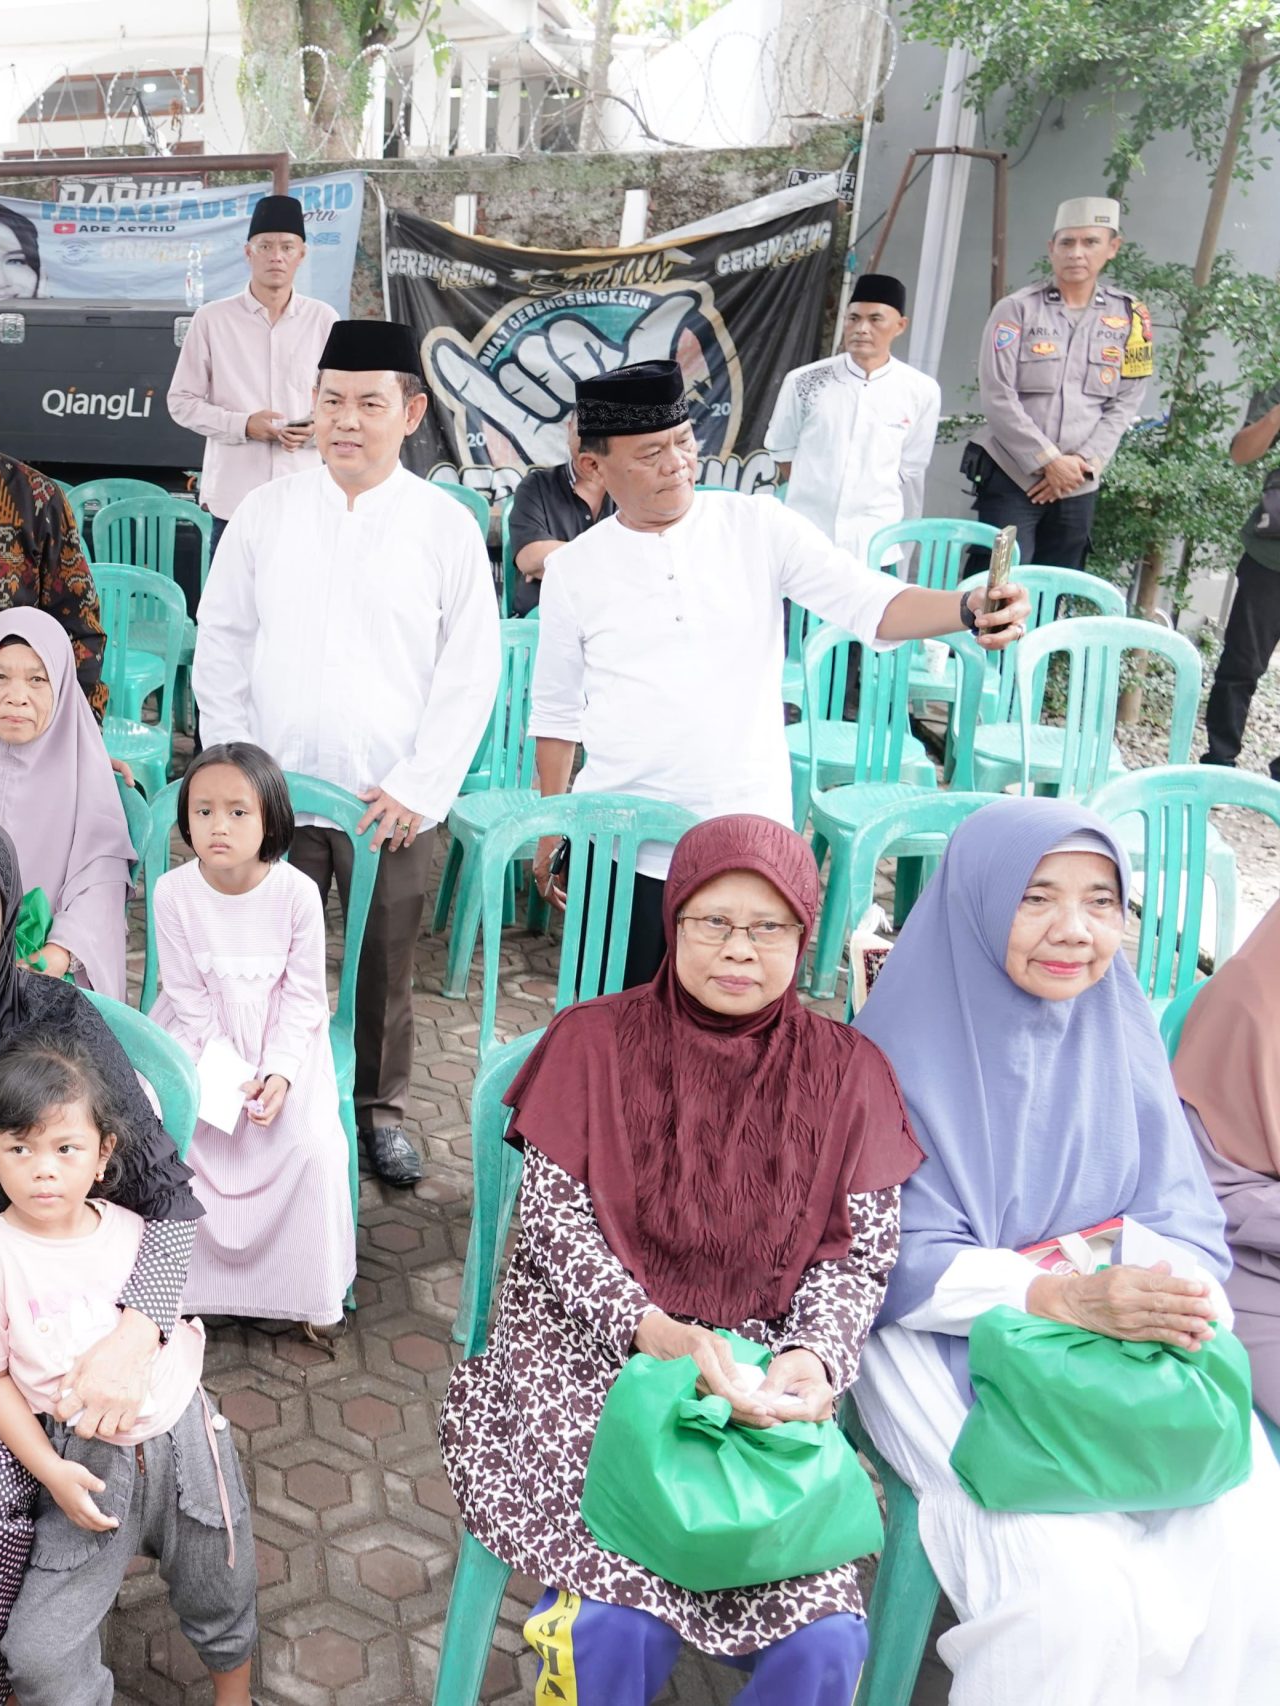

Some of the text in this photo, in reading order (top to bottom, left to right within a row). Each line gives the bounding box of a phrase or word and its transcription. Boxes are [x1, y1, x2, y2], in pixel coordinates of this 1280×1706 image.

[177, 198, 238, 221] ADE
[79, 225, 111, 233] ADE
[508, 290, 652, 330] GERENGSENGKEUN
[42, 386, 154, 420] QiangLi
